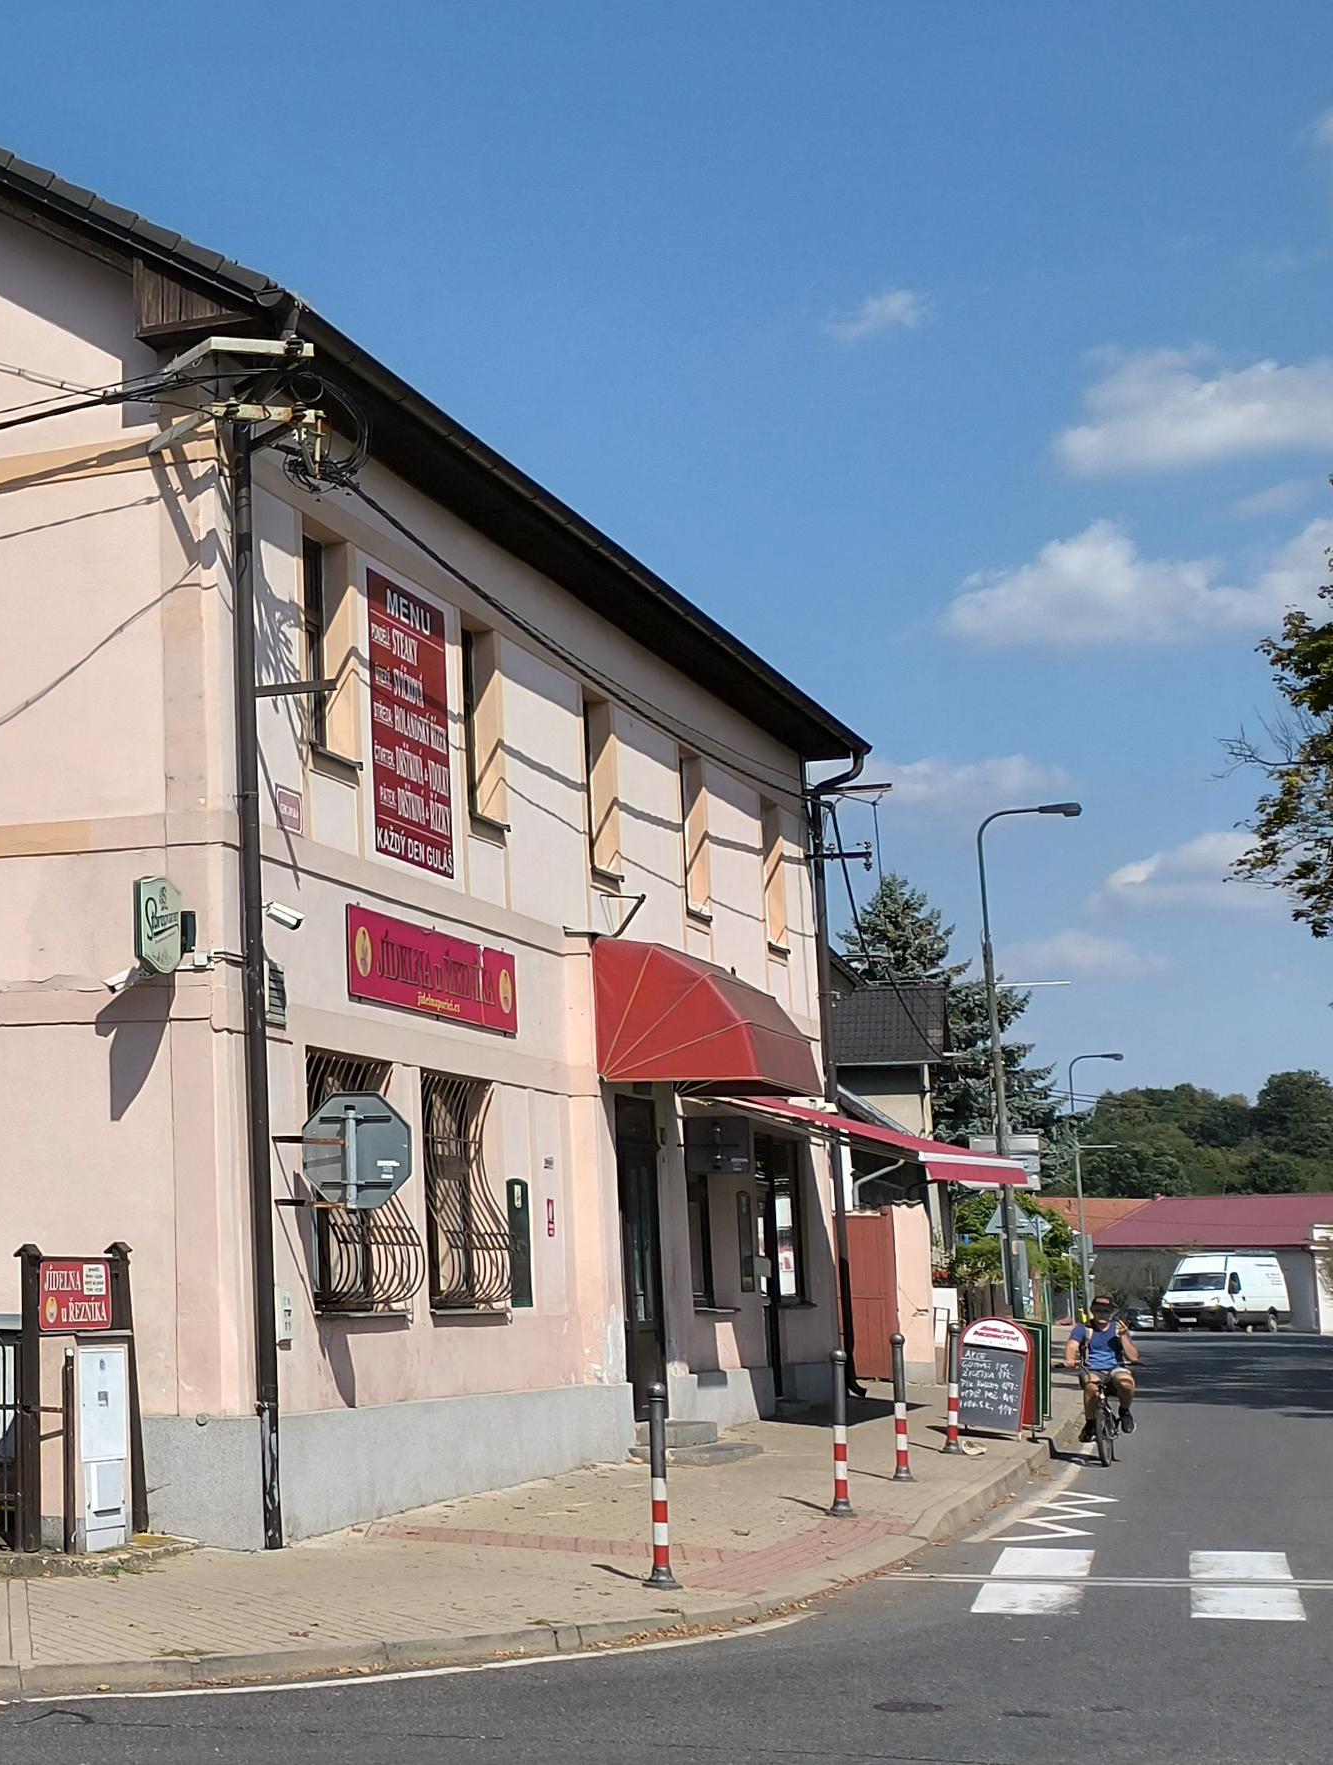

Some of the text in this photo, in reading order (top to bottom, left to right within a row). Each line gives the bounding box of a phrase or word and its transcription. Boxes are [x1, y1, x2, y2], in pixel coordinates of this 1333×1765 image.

[386, 588, 430, 636] MENU
[393, 628, 418, 666] STEAKY
[393, 664, 424, 708] SVÍČKOVÁ
[394, 704, 431, 746] HOLANDSKÝ
[430, 714, 448, 754] ŘÍZEK
[428, 759, 449, 797] VDOLKY
[429, 792, 451, 836] ŘÍZKY
[377, 824, 453, 874] KAŽDÝ DEN GULÁŠ
[378, 929, 433, 991] JÍDELNA
[44, 1264, 81, 1291] JÍDELNA
[61, 1297, 107, 1322] u ŘEZNÍKA
